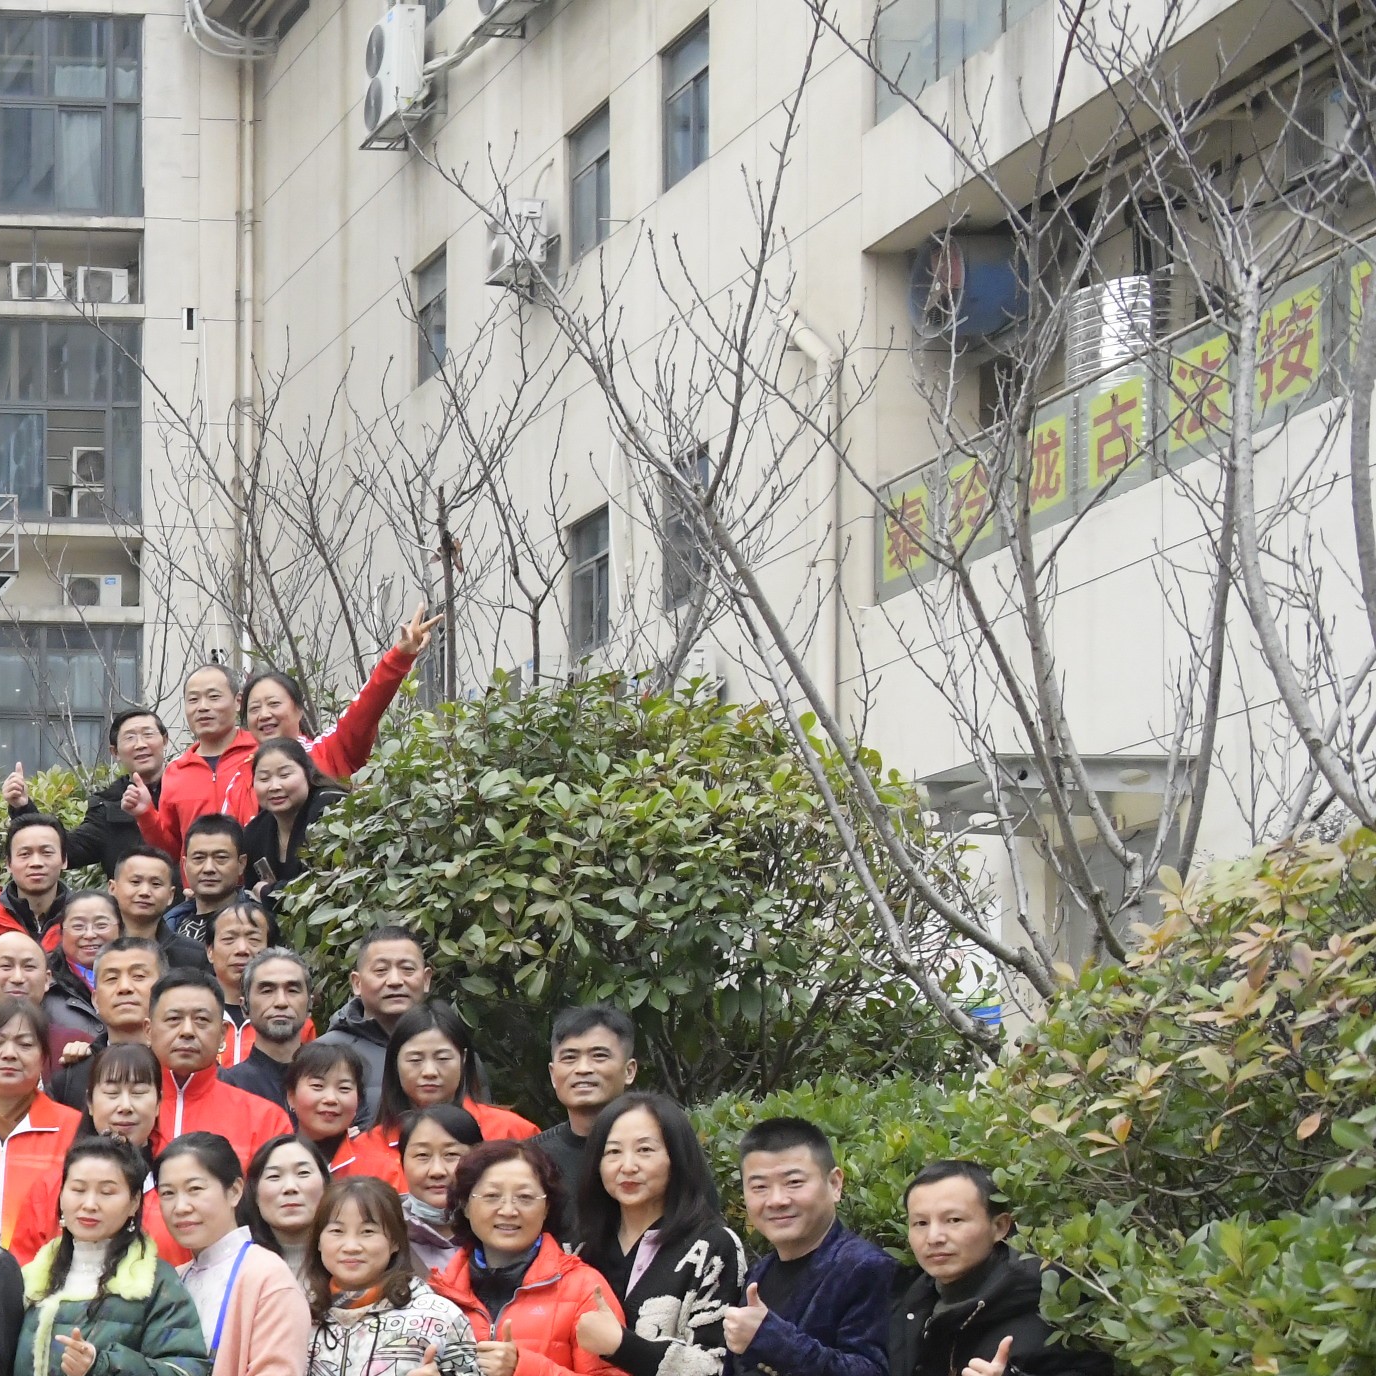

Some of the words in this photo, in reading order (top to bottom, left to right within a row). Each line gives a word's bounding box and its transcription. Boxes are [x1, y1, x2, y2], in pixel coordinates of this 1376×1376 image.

[885, 275, 1372, 570] 泰玲珑古法按
